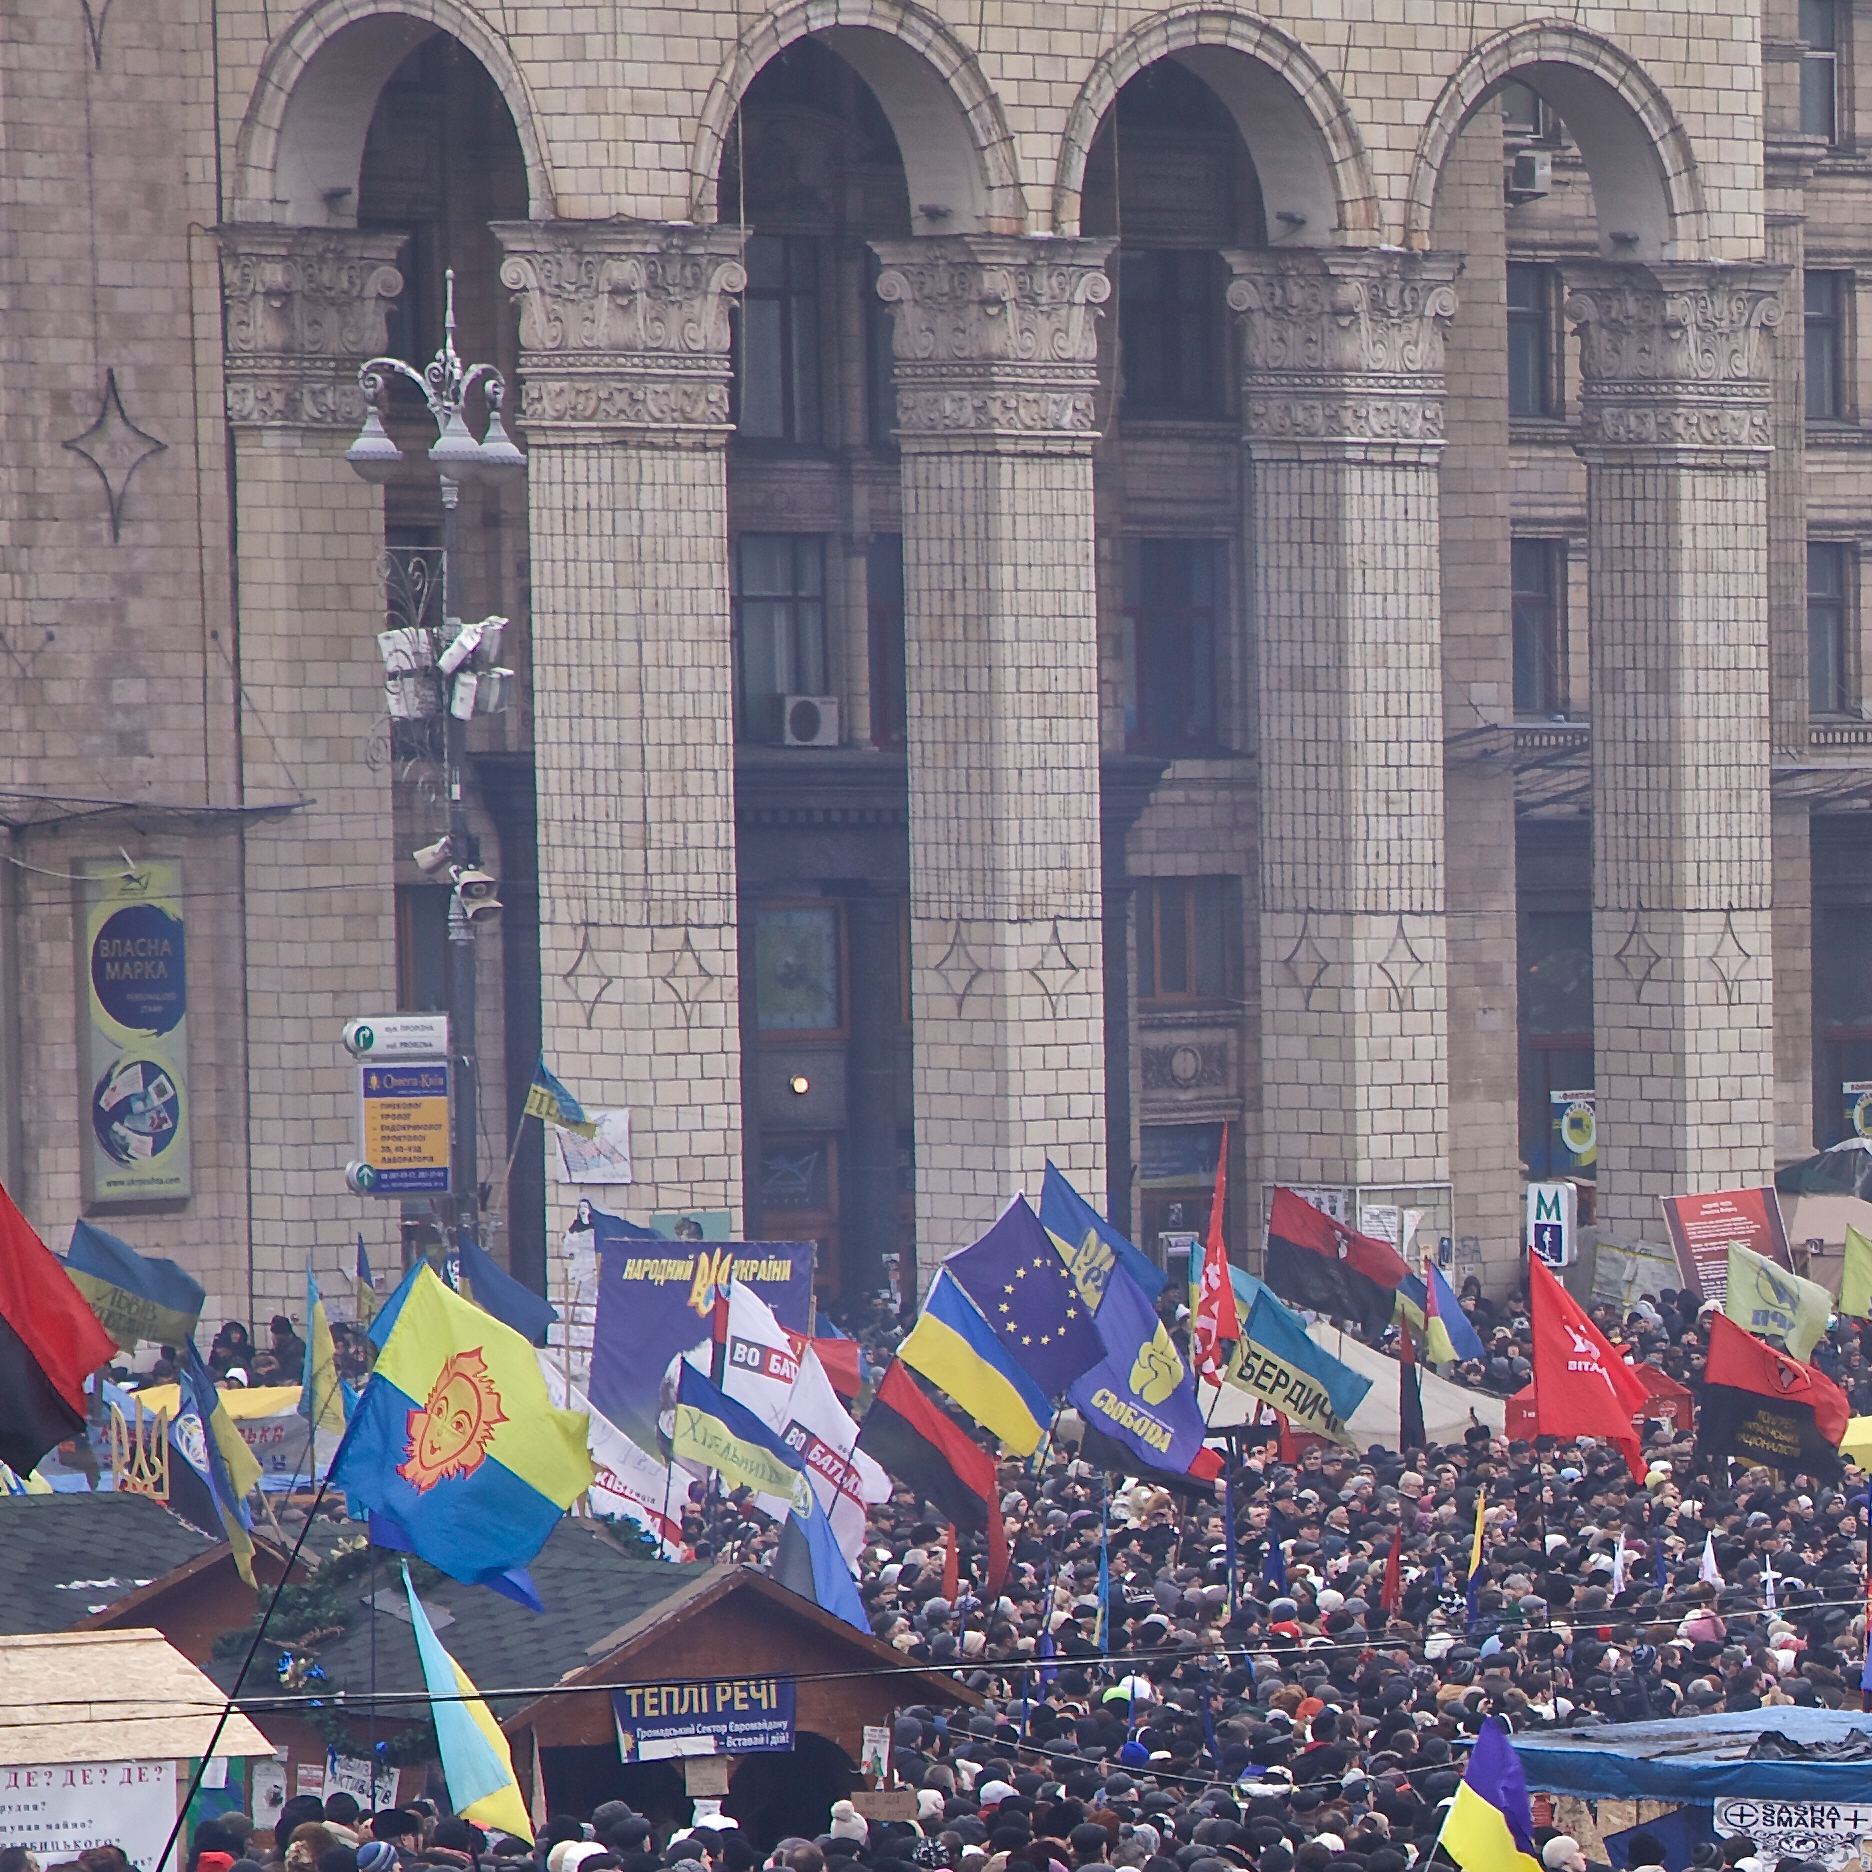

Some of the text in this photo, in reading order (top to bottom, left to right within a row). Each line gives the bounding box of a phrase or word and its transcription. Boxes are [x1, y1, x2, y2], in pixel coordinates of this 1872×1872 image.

[100, 939, 172, 958] ВЛАСНА
[105, 962, 168, 980] МАРКА
[623, 1254, 694, 1286] НАРОДНИЙ
[733, 1343, 760, 1367] ВО
[1090, 1388, 1173, 1453] СВОБОДА
[784, 1427, 806, 1451] ВО
[625, 1680, 777, 1718] ТЕПЛІ РЕЧІ
[636, 1719, 788, 1739] Громадський Сектор Євромайдану
[726, 1736, 765, 1748] Вставай
[770, 1732, 789, 1747] дій!
[5, 1766, 163, 1790] ДЕ? ДЕ? ДЕ?
[1762, 1804, 1841, 1820] SASHA
[1762, 1817, 1837, 1830] SMART
